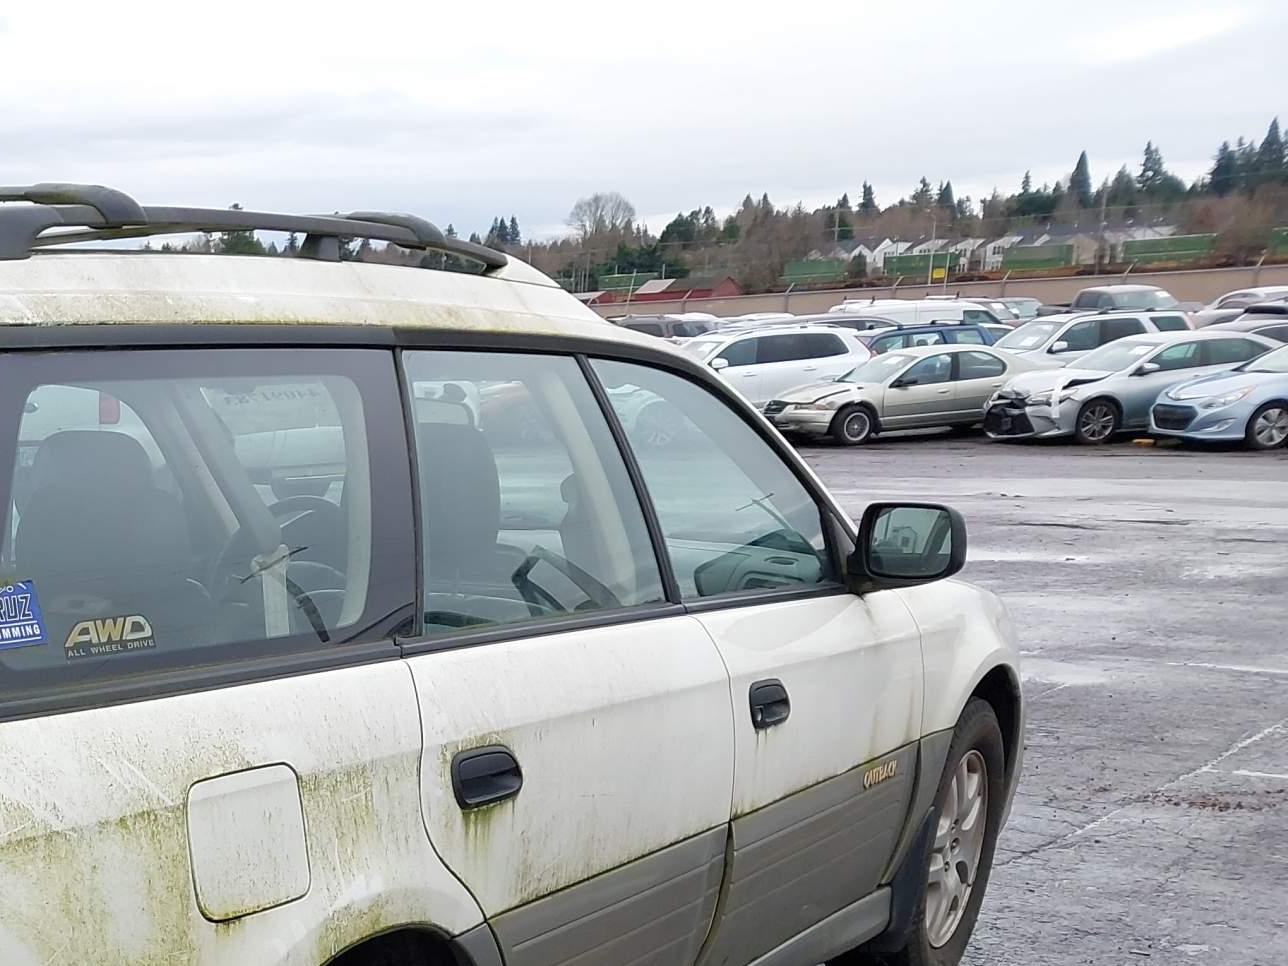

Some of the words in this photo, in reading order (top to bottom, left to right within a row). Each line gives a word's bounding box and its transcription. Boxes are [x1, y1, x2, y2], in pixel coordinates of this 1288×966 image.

[65, 615, 153, 647] AWD
[68, 649, 86, 658] ALL
[90, 643, 123, 655] WHEEL
[127, 638, 156, 650] DRIVE
